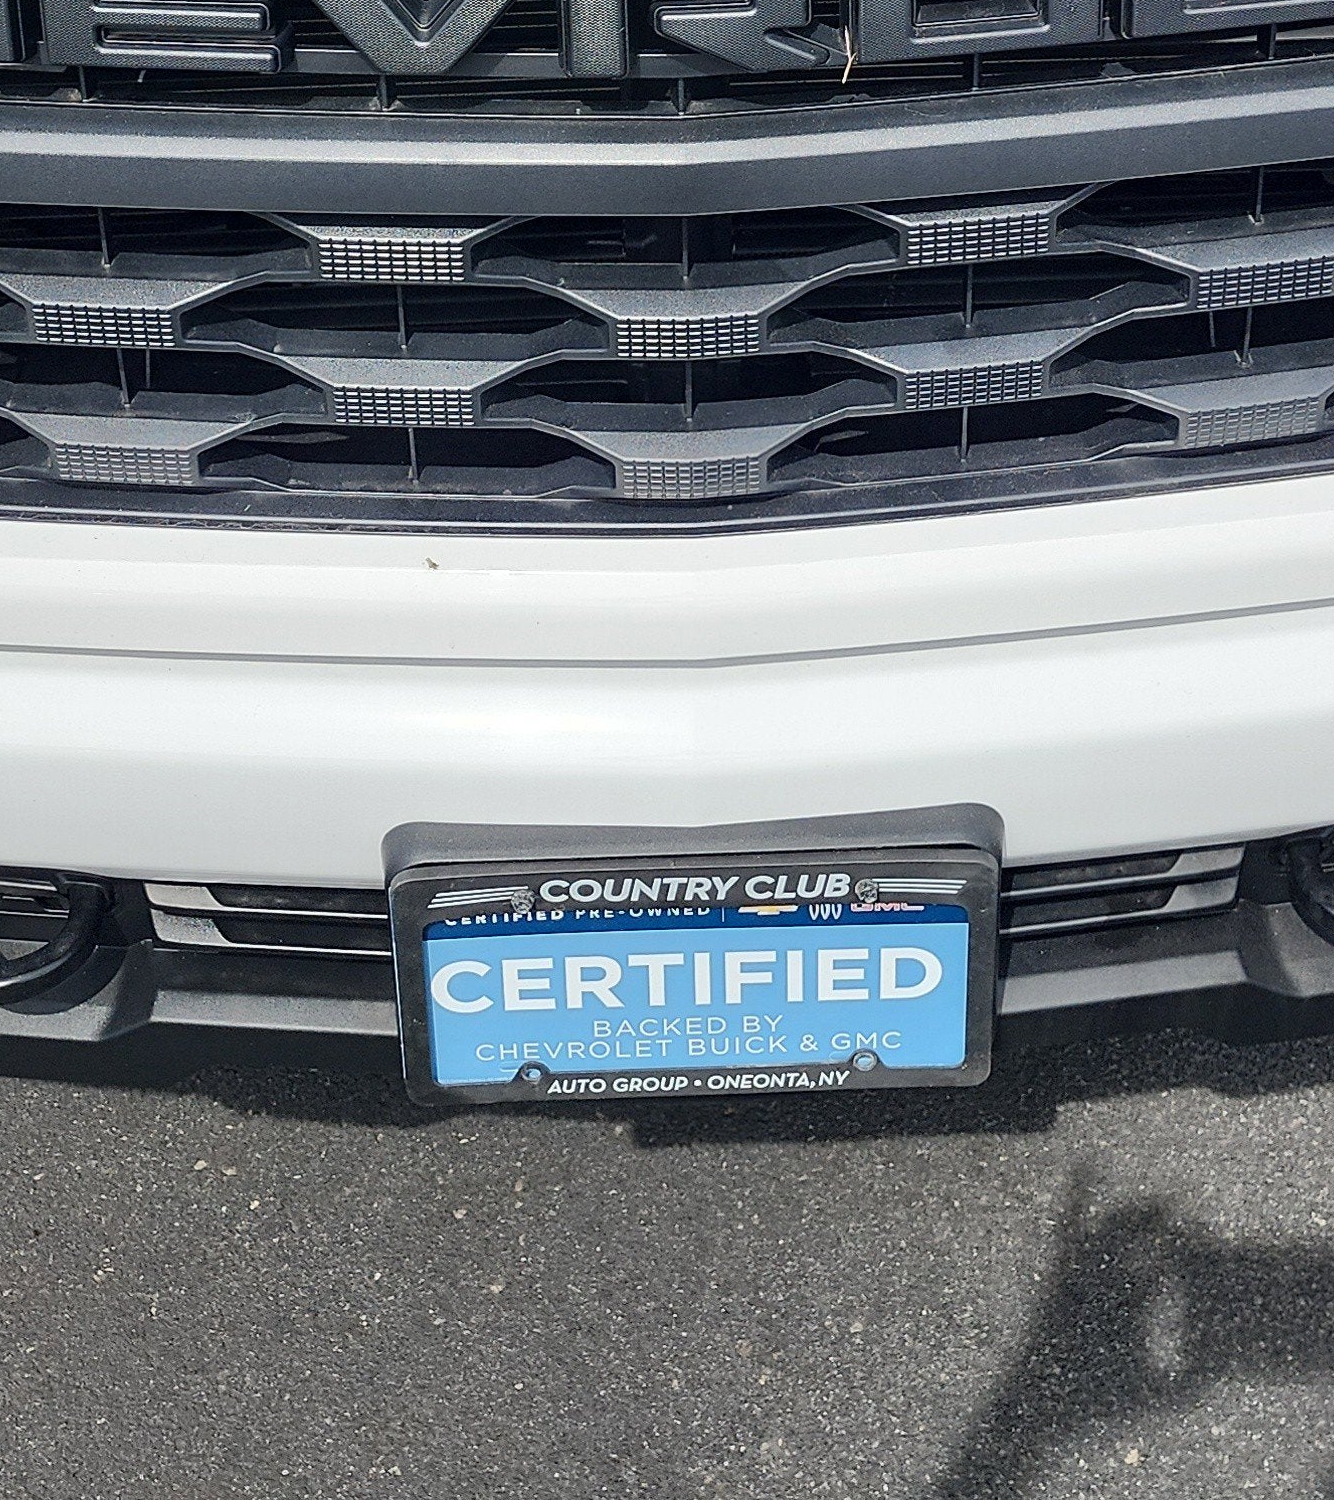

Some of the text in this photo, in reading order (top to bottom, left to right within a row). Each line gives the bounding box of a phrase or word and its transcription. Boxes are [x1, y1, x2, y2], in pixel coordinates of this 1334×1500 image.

[539, 873, 851, 903] COUNTRY CLUB
[430, 945, 943, 1014] CERTIFIED
[593, 1014, 784, 1038] BACKED BY
[475, 1031, 902, 1062] CHEVROLET BUICK & GMC
[547, 1077, 607, 1095] AUTO
[611, 1074, 689, 1093] GROUP
